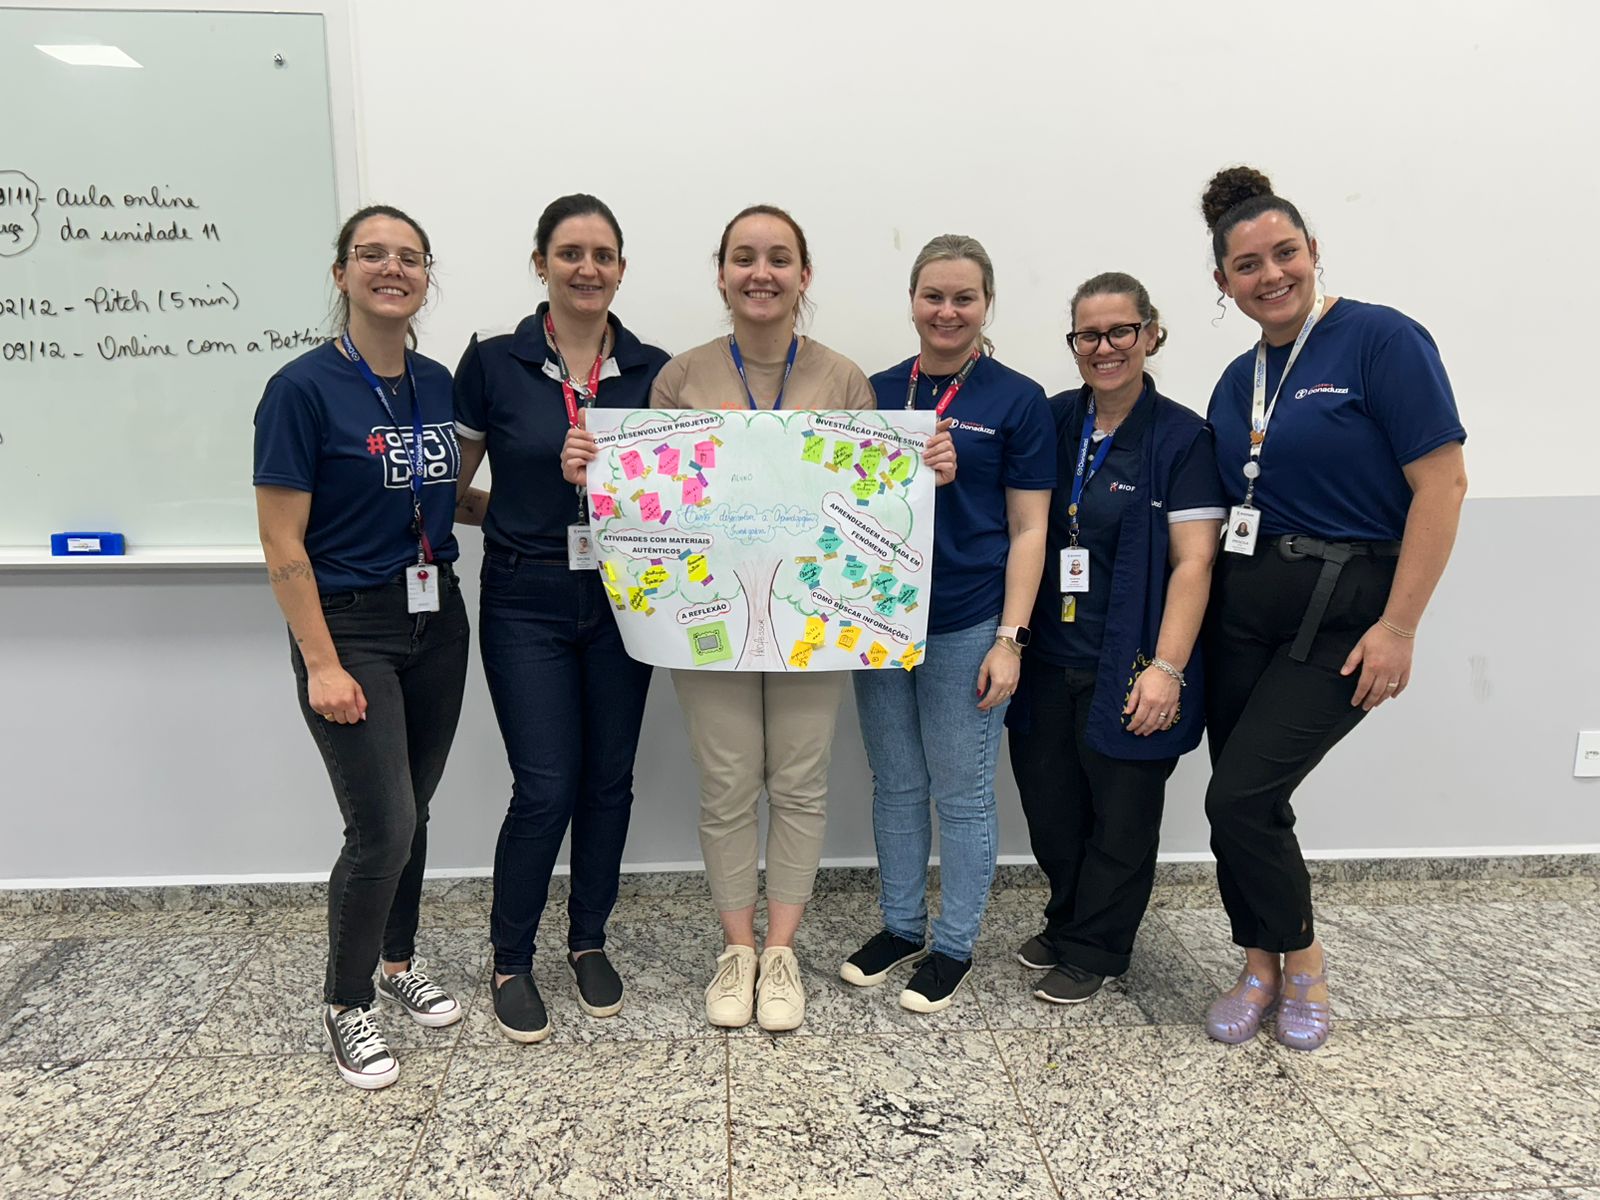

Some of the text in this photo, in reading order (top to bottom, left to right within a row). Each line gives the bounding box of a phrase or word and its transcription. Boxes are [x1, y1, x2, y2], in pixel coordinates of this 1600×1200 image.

[123, 184, 199, 208] online
[60, 216, 90, 242] da
[101, 220, 192, 242] unidade
[202, 223, 220, 242] 11
[84, 286, 149, 314] Pitch
[2, 340, 66, 362] 09/12
[97, 335, 178, 361] Online
[186, 338, 237, 355] com
[247, 341, 263, 354] a
[1307, 387, 1349, 395] Donaduzzi
[593, 416, 719, 444] COMO DESENVOLVER PROJETOS?
[815, 418, 925, 448] INVESTIGAÇÃO PROGRESSIVA
[960, 423, 996, 435] Donaduzzi
[1078, 438, 1089, 468] Donaduzzi
[603, 535, 648, 543] ATIVIDADES
[669, 536, 711, 545] MATERIAIS
[829, 502, 921, 567] APRENDIZAGEM BASEADA EM
[850, 530, 888, 558] FENÔMENO
[688, 603, 727, 618] REFLEXÃO
[812, 591, 910, 641] COMO BUSCAR INFORMAÇÕES
